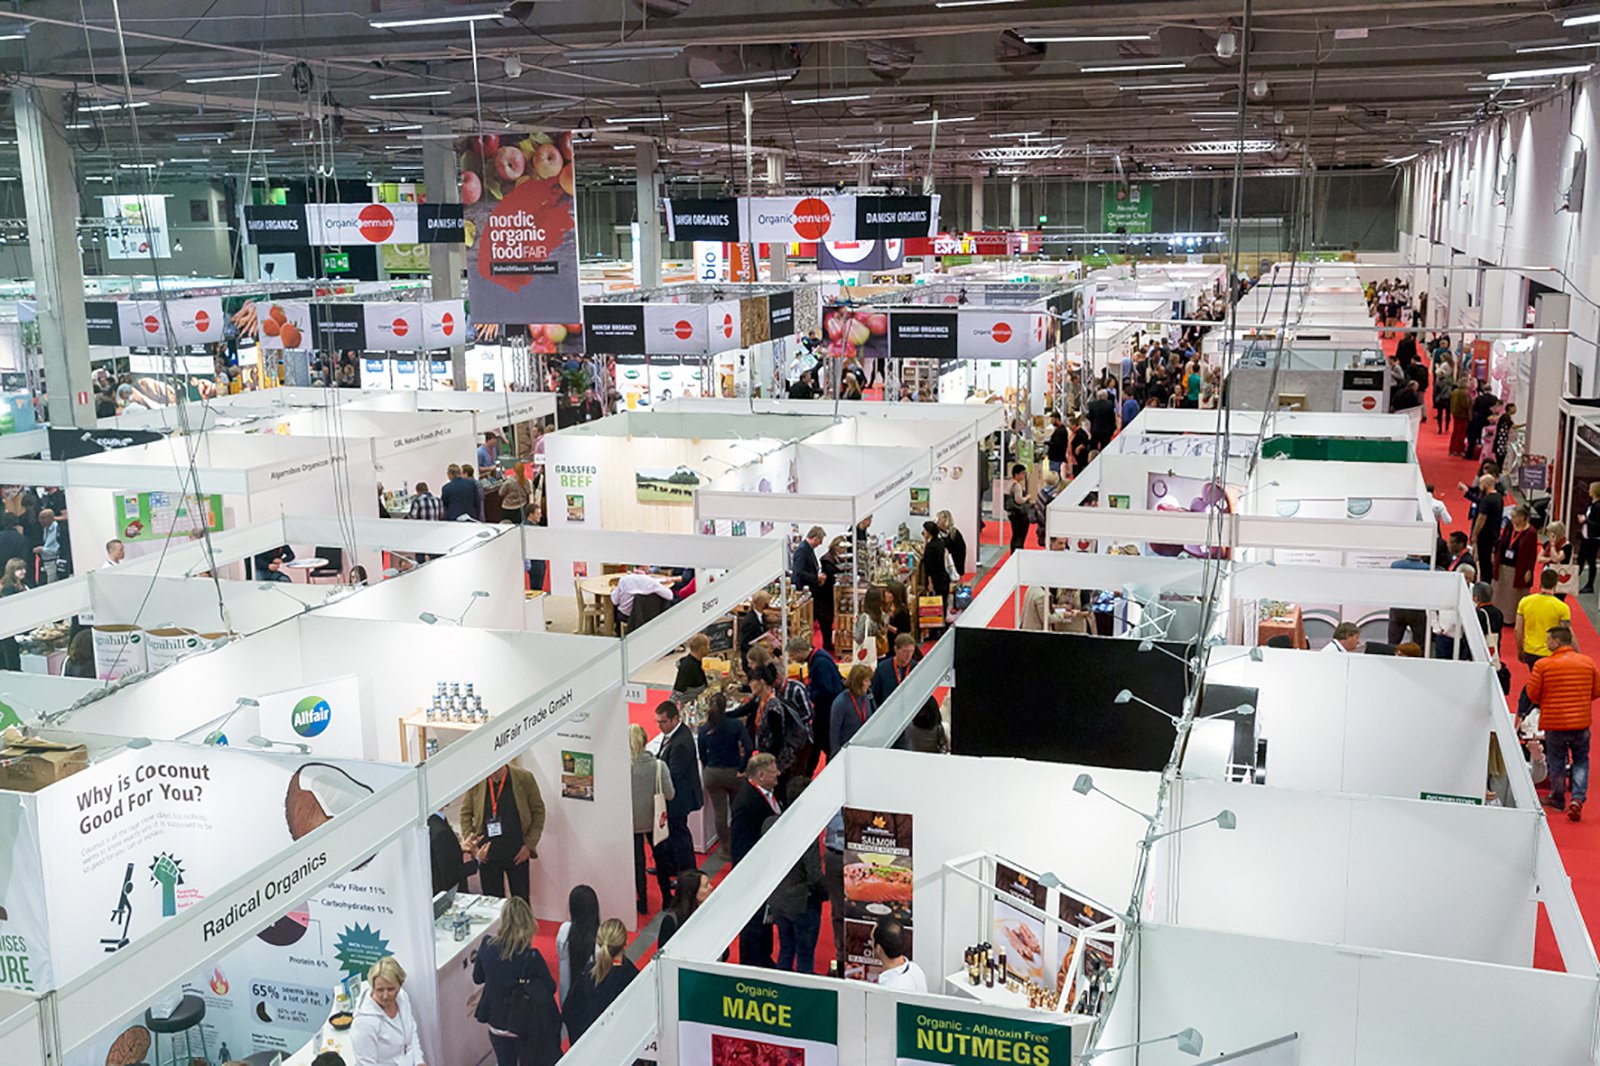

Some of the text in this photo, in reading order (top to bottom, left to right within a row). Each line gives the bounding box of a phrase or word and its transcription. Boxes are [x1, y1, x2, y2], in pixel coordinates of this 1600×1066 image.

[428, 218, 457, 230] DANISH
[489, 210, 535, 227] nordic
[693, 214, 729, 226] ORGANICS
[866, 211, 927, 224] DANISH ORGANICS
[490, 226, 546, 246] organic
[491, 243, 548, 259] food FAIR
[920, 325, 949, 333] ORGANICS
[555, 464, 597, 474] GRASSFED
[560, 475, 593, 488] BEEF
[293, 707, 330, 727] Allfair
[493, 689, 573, 751] AllFair Trade GmbH
[76, 764, 210, 812] Why is Coconut
[79, 783, 203, 834] Good For You?
[861, 836, 897, 848] SALMON
[202, 851, 327, 942] Radical Organics
[348, 884, 367, 892] Fiber
[369, 886, 386, 895] 11%
[320, 898, 393, 914] Carbohydrates 11%
[289, 956, 315, 967] Protein
[252, 983, 319, 1000] 65% seems like
[288, 994, 299, 1002] lot
[735, 982, 779, 998] Organic
[722, 995, 792, 1027] MACE
[916, 1014, 962, 1030] Organic
[972, 1024, 1022, 1039] Aflatoxin
[1024, 1031, 1049, 1043] Free
[916, 1028, 1050, 1066] NUTMEGS
